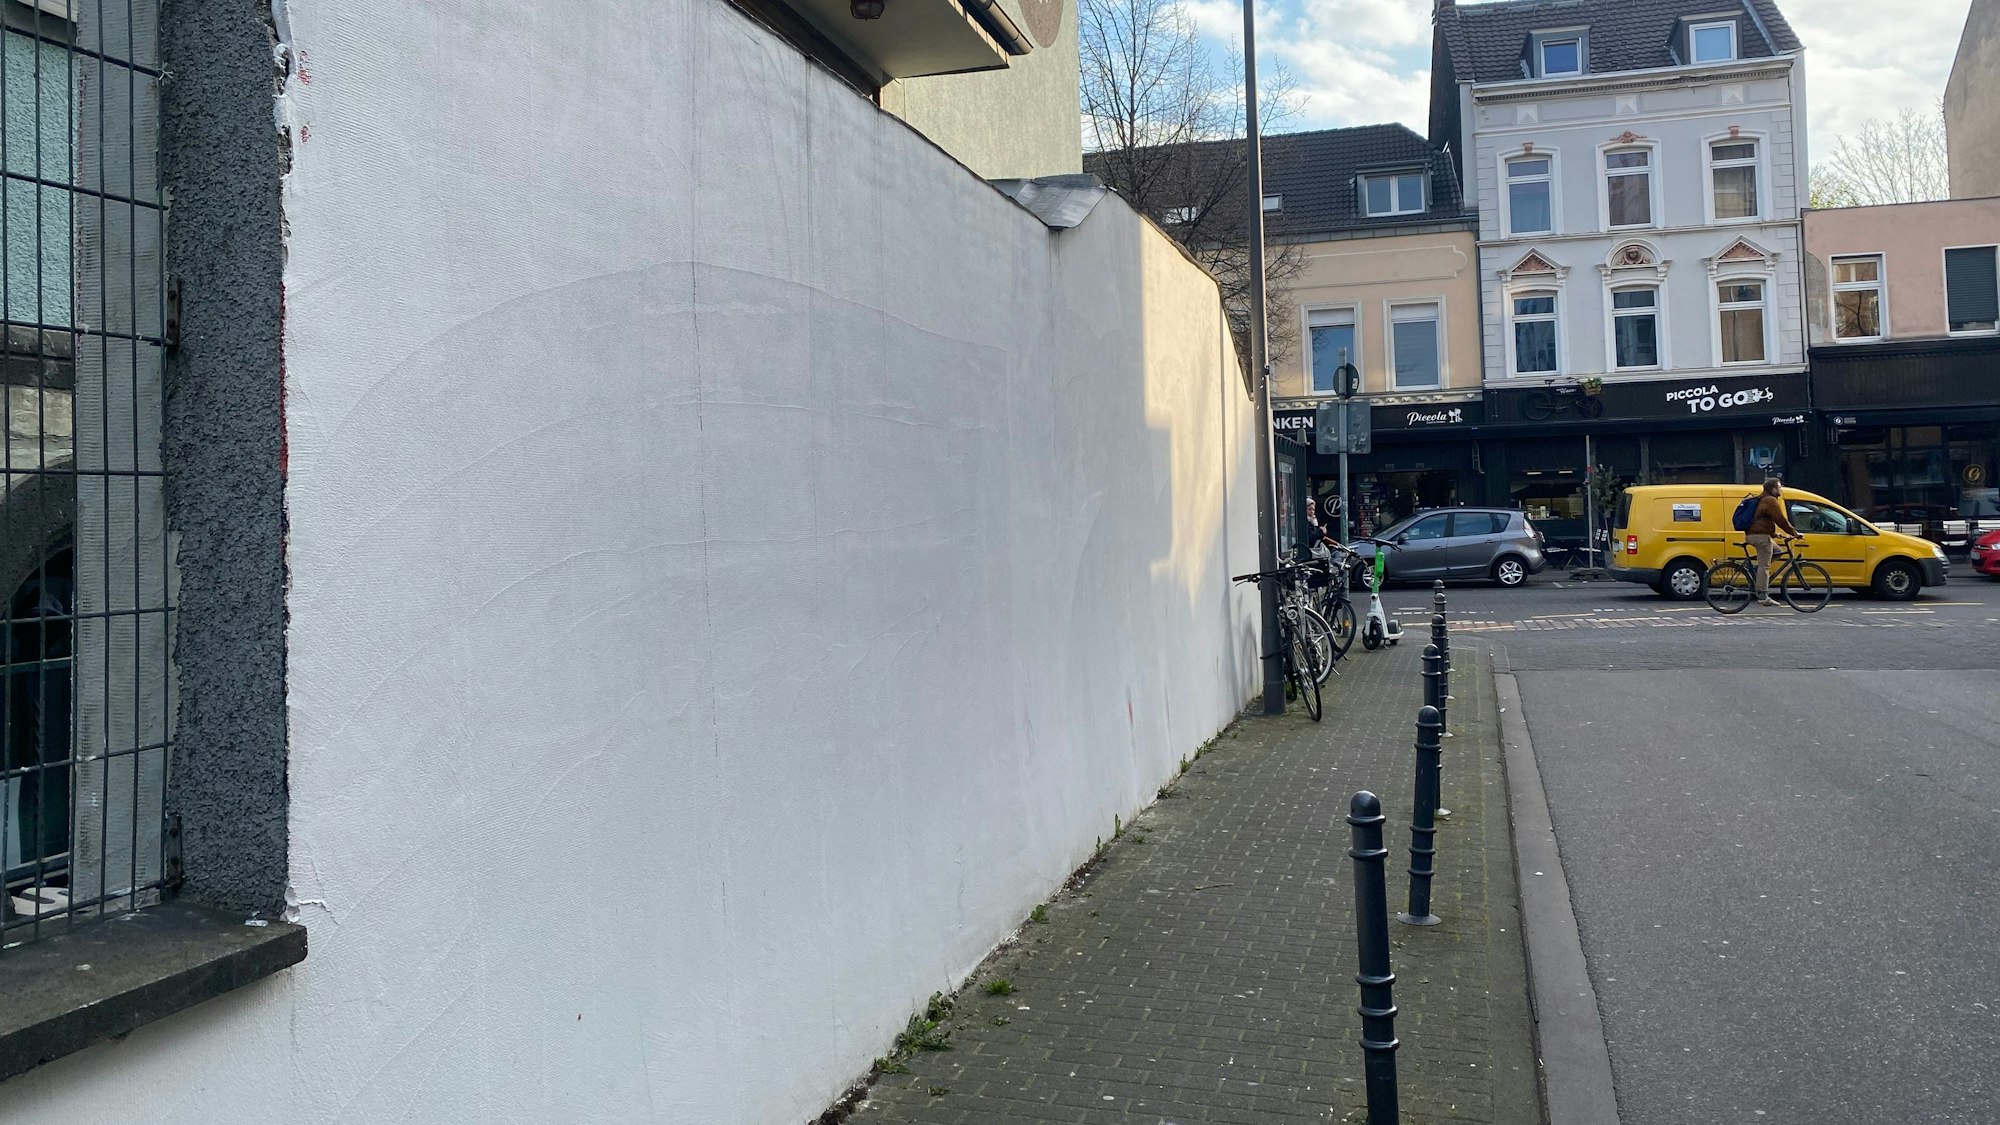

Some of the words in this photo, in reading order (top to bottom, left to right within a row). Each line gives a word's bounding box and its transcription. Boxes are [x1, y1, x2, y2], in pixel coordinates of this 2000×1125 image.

[1666, 385, 1719, 401] PICCOLA
[1687, 396, 1715, 413] TO
[1718, 390, 1748, 408] GO
[1406, 411, 1447, 425] Piccola
